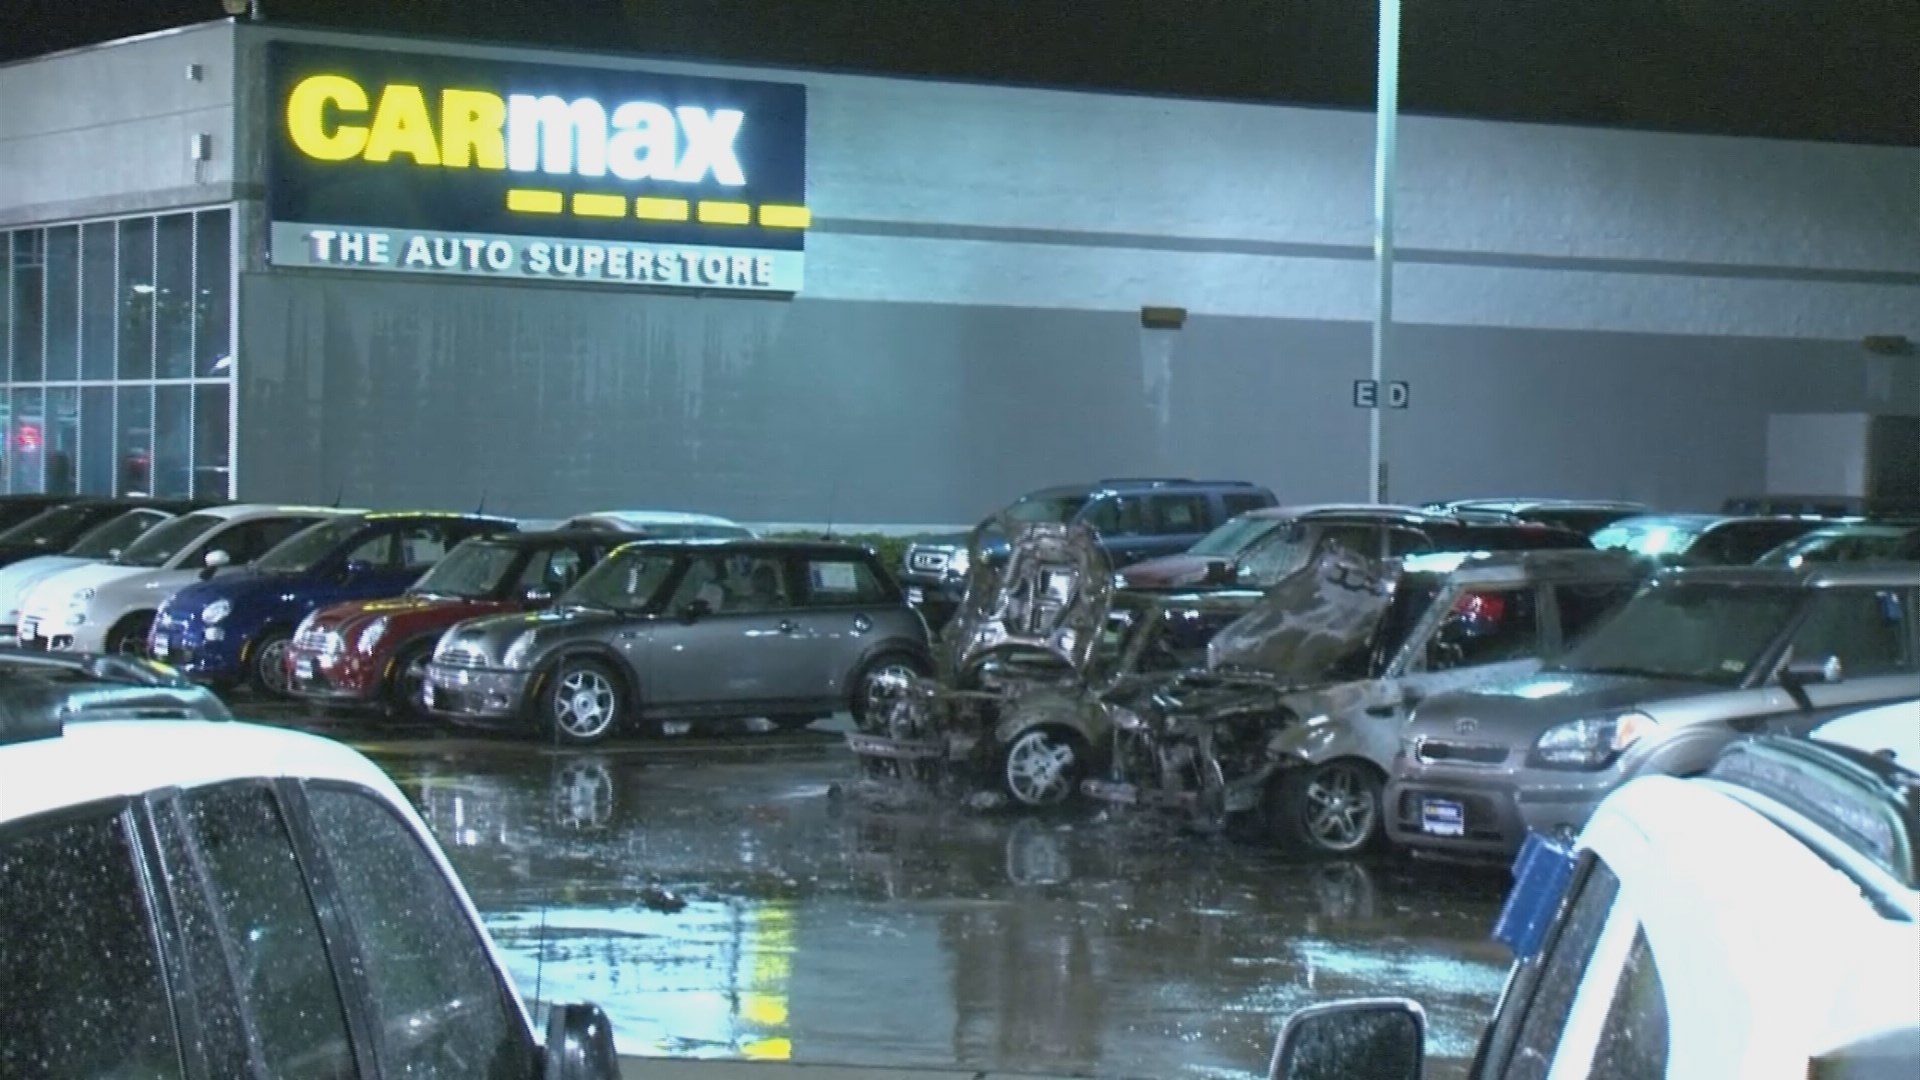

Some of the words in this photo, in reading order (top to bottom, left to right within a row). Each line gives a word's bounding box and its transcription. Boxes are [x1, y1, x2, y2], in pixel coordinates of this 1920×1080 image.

[286, 74, 747, 186] CARmax
[309, 230, 390, 265] THE
[405, 235, 514, 271] AUTO
[528, 242, 773, 288] SUPERSTORE
[1357, 383, 1374, 406] E
[1389, 383, 1407, 407] D
